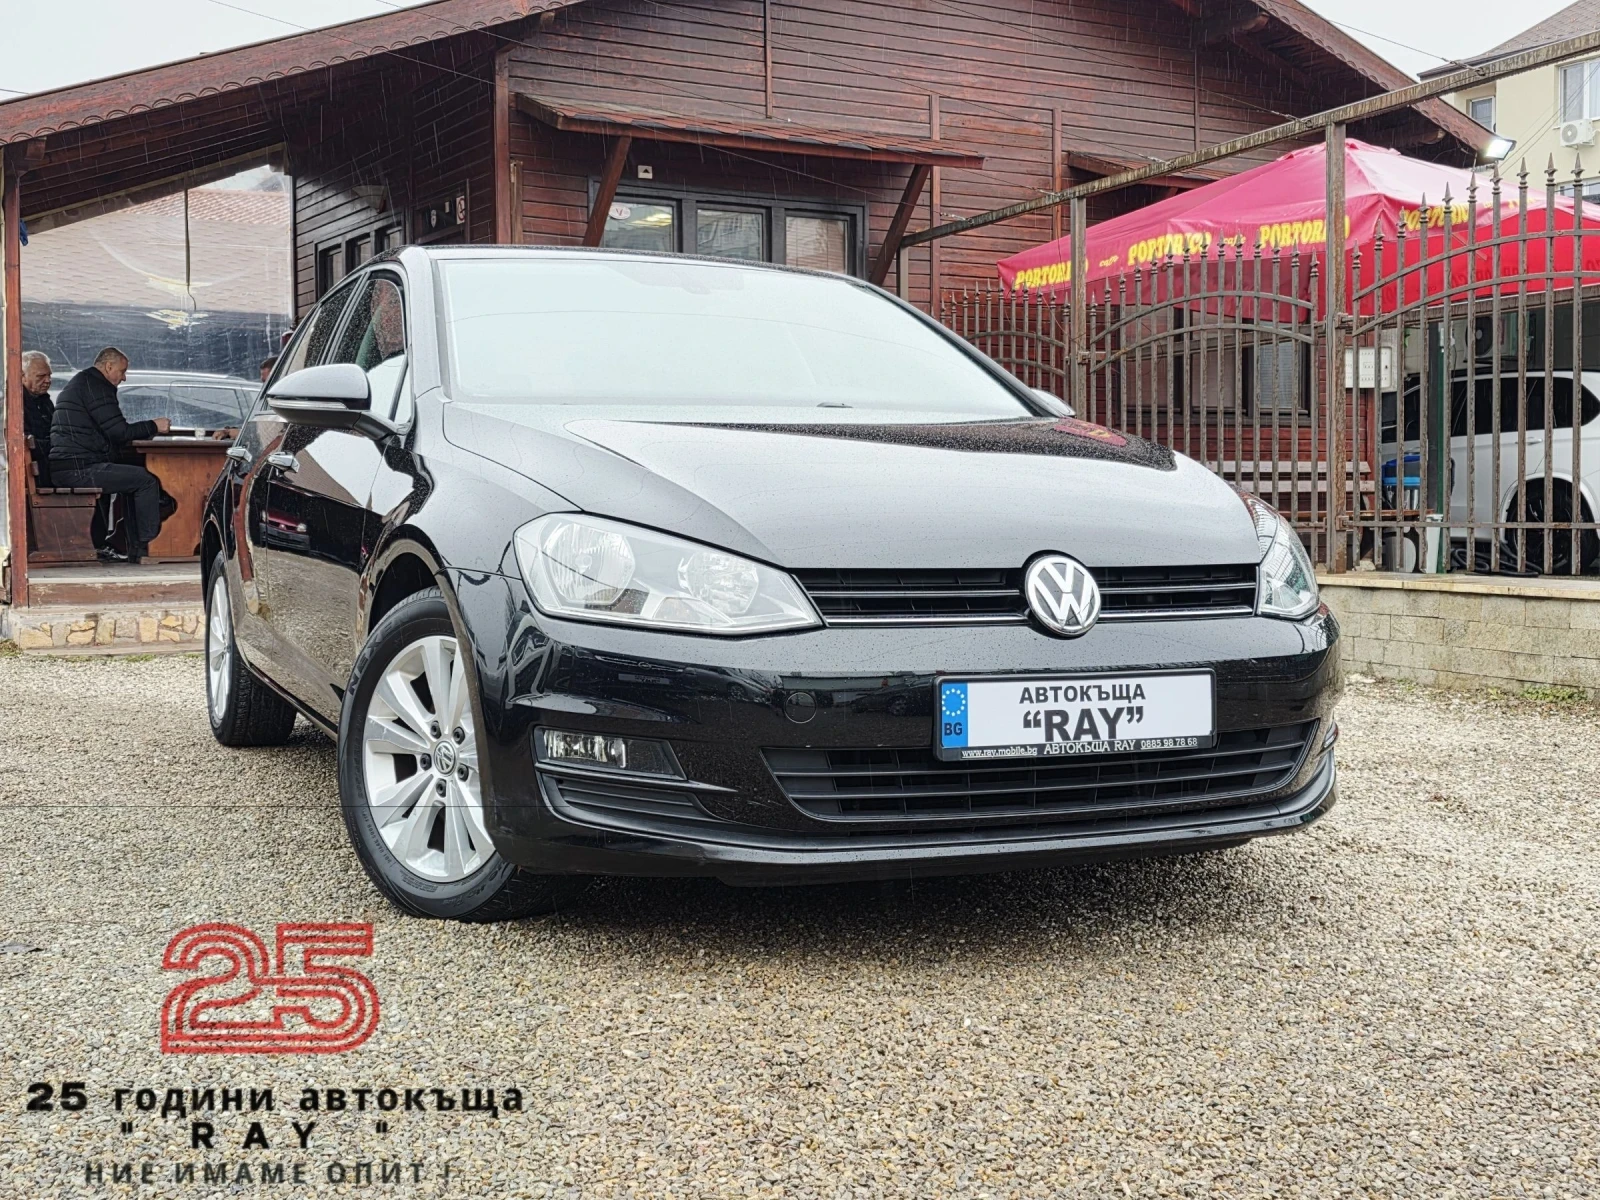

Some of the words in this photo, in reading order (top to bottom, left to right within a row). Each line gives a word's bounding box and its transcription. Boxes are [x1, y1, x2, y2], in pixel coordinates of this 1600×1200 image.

[1014, 258, 1089, 291] PORTORI
[1019, 683, 1146, 704] АВТОКЪЩА
[944, 722, 963, 736] BG
[1043, 741, 1111, 755] АВТОКЪЩА
[1114, 740, 1136, 751] RAY
[1140, 739, 1161, 750] 0885
[1163, 739, 1174, 748] 98
[1175, 738, 1186, 747] 78
[1187, 737, 1198, 747] 68
[961, 746, 1038, 759] www.ray.mobile.bg
